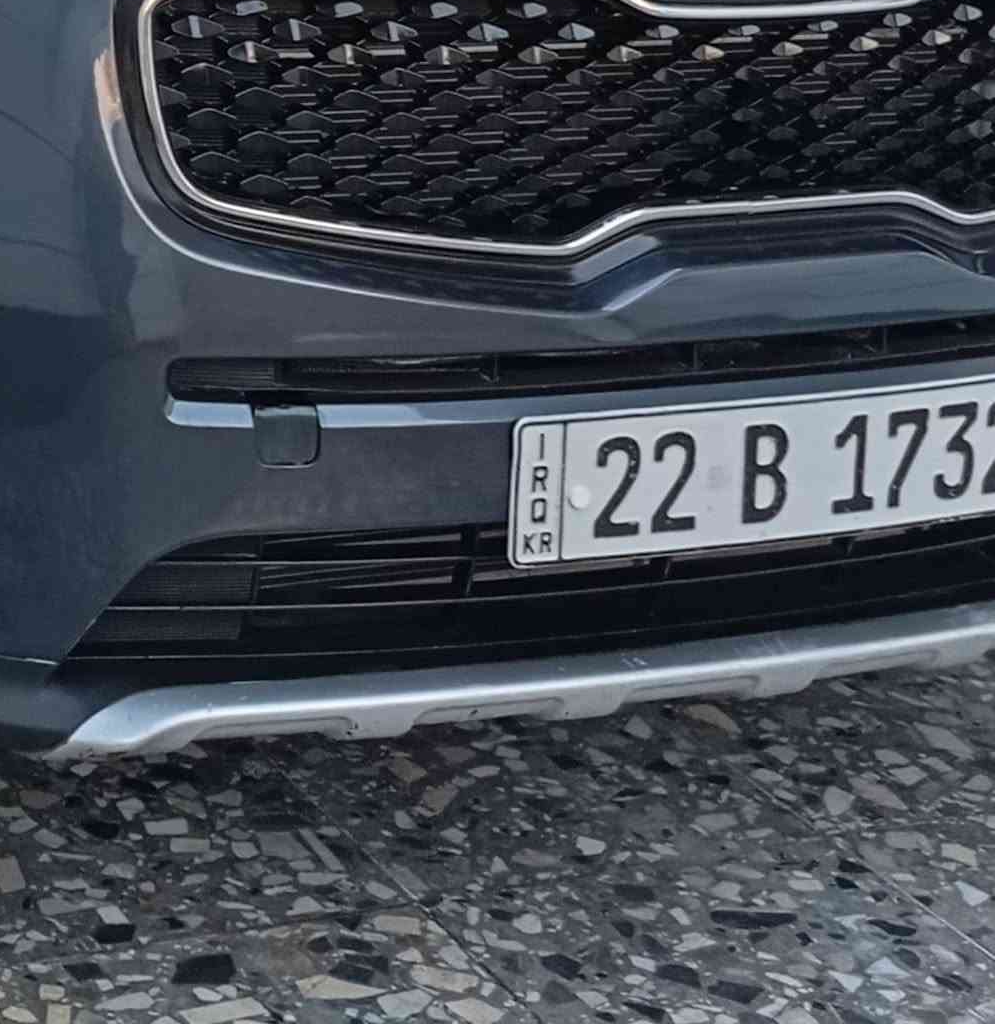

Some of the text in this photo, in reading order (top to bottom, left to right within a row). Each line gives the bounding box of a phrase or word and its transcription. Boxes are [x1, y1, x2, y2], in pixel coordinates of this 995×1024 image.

[593, 431, 696, 538] 22
[741, 423, 789, 524] B
[522, 531, 553, 555] KR
